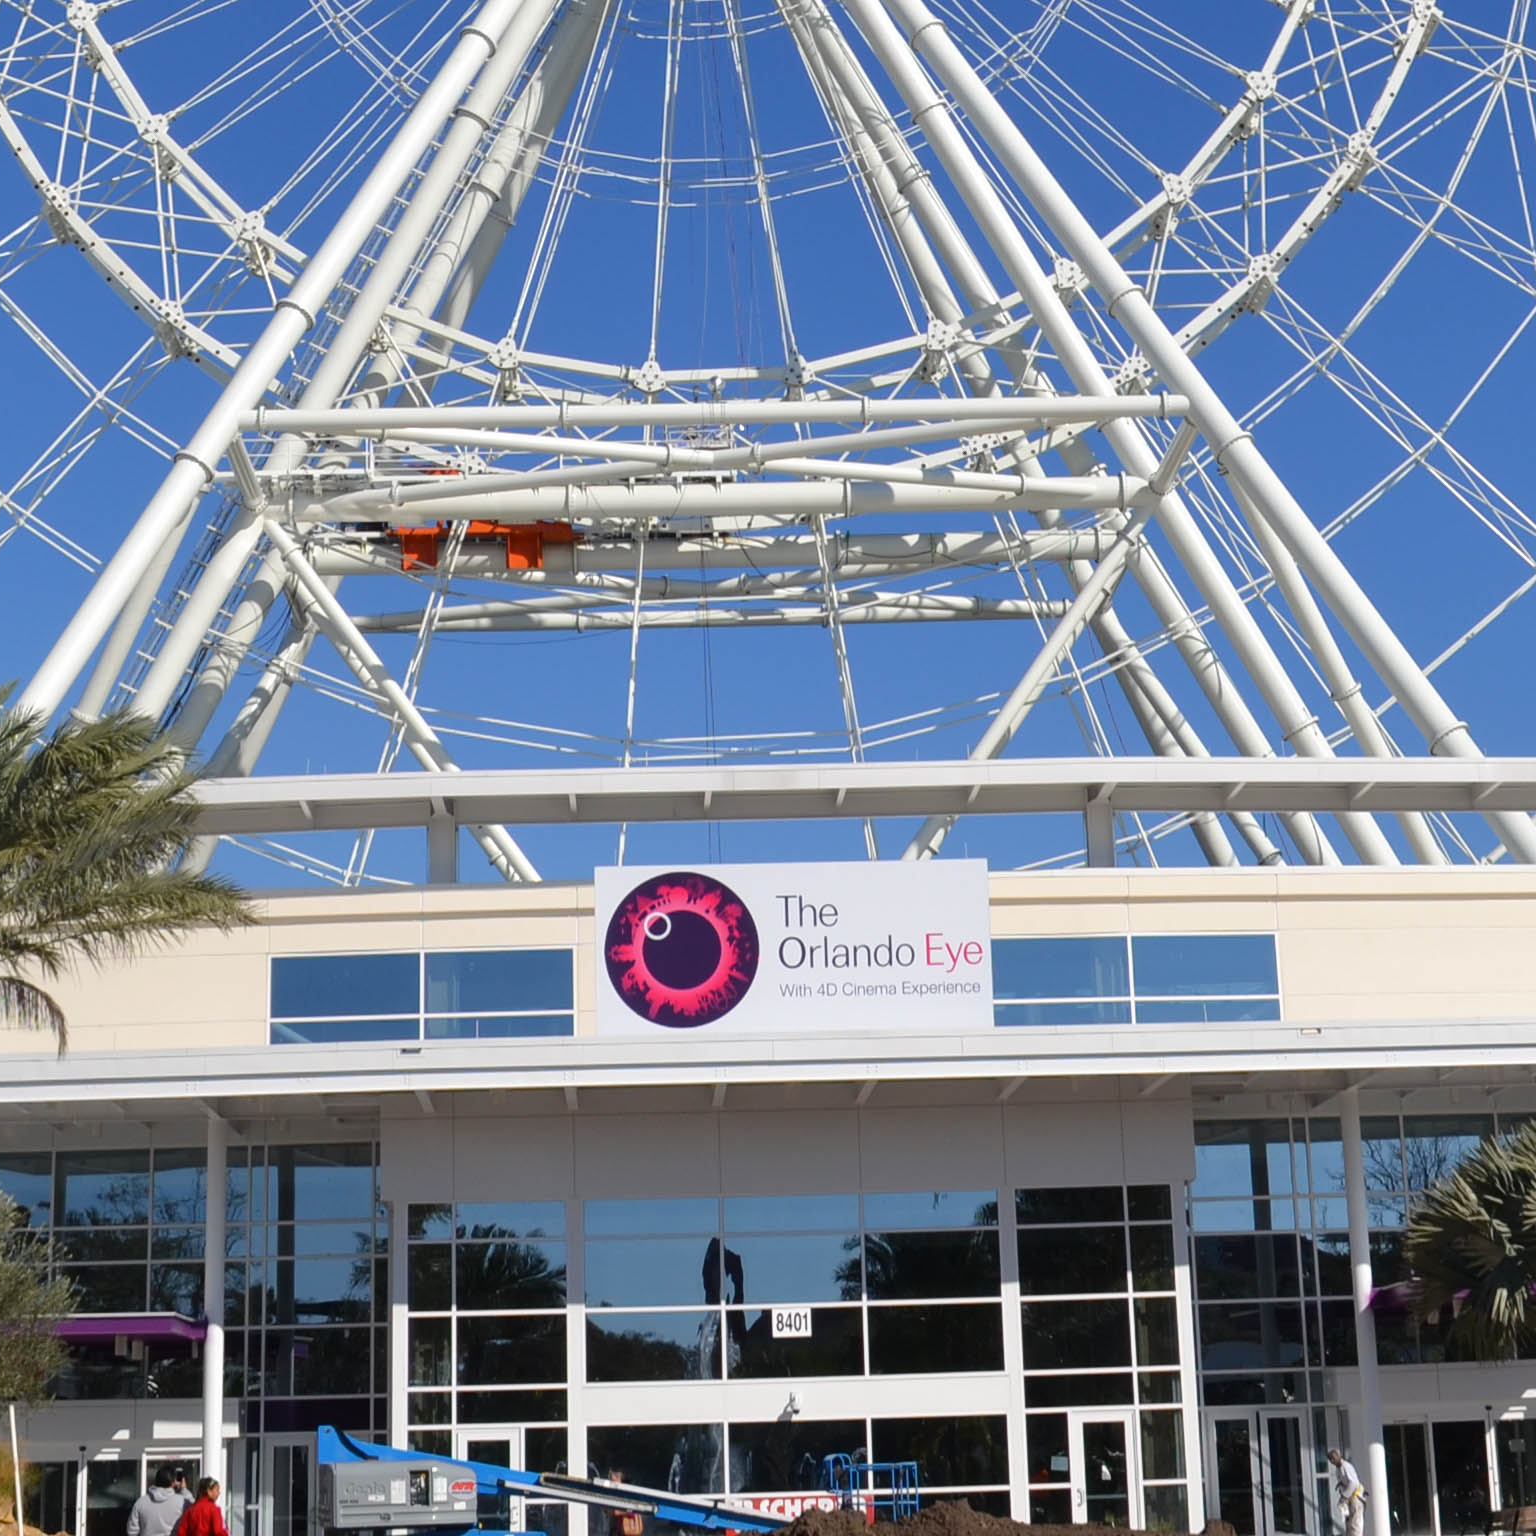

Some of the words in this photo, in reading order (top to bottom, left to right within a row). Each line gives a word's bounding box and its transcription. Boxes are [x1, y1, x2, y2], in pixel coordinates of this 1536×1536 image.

[775, 895, 838, 928] The
[778, 934, 915, 969] Orlando
[925, 932, 983, 973] Eye
[779, 982, 812, 998] With
[817, 982, 838, 997] 4D
[842, 981, 897, 996] Cinema
[902, 980, 981, 997] Experience
[775, 1312, 808, 1332] 8401
